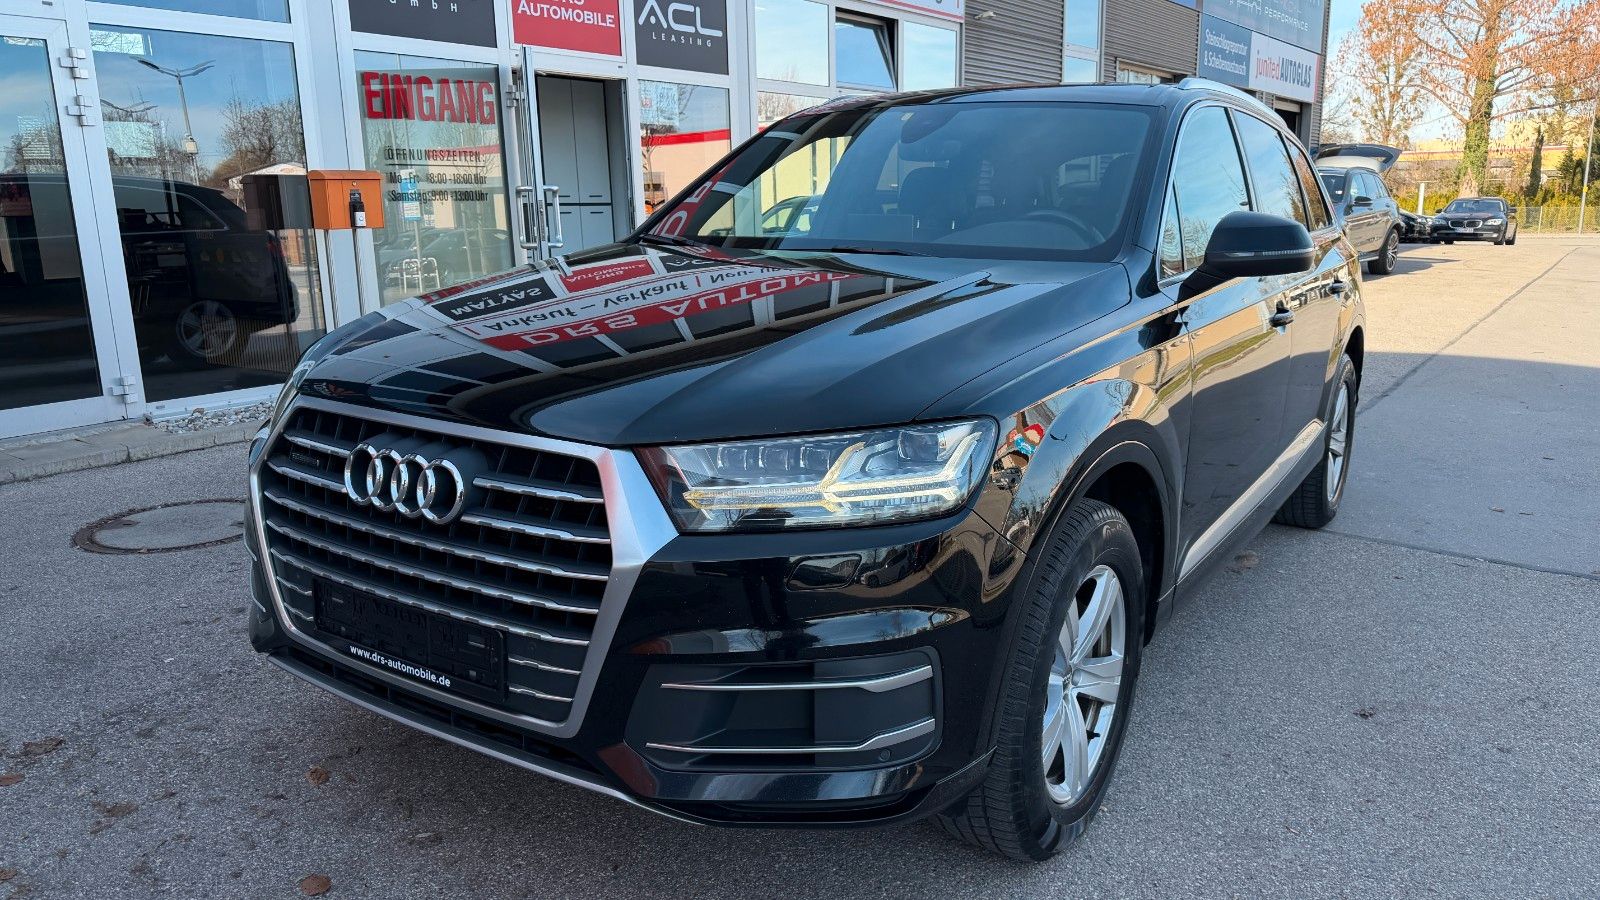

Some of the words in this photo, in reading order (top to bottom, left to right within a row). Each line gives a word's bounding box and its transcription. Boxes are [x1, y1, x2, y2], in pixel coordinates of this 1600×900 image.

[517, 0, 615, 27] AUTOMOBILE
[638, 0, 723, 37] ACL
[652, 31, 712, 47] LEASING
[362, 71, 496, 125] EINGANG
[389, 172, 402, 183] Mo
[474, 174, 487, 185] Uhr
[475, 190, 488, 202] Uhr
[350, 645, 451, 687] www.drs-automobile.de
